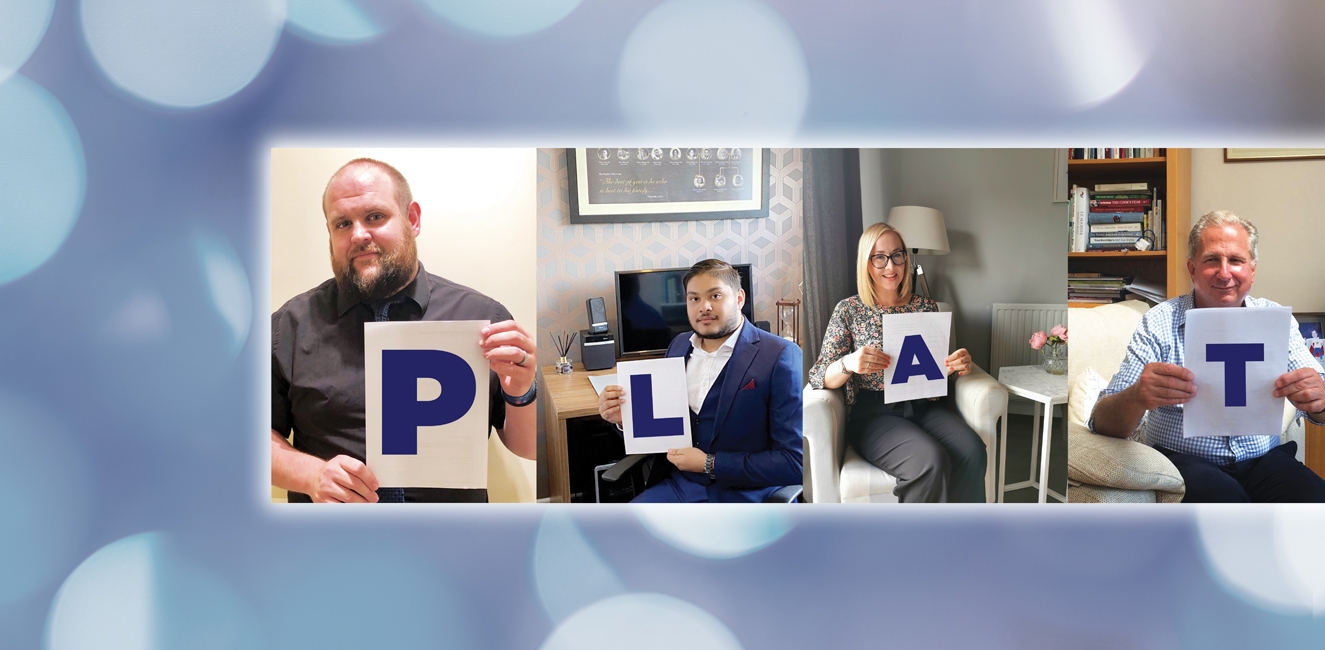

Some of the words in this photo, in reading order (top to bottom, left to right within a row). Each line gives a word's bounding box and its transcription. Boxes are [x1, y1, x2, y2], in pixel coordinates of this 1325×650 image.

[891, 334, 944, 384] A
[1206, 344, 1264, 407] T
[382, 350, 476, 454] P
[631, 374, 684, 438] L
